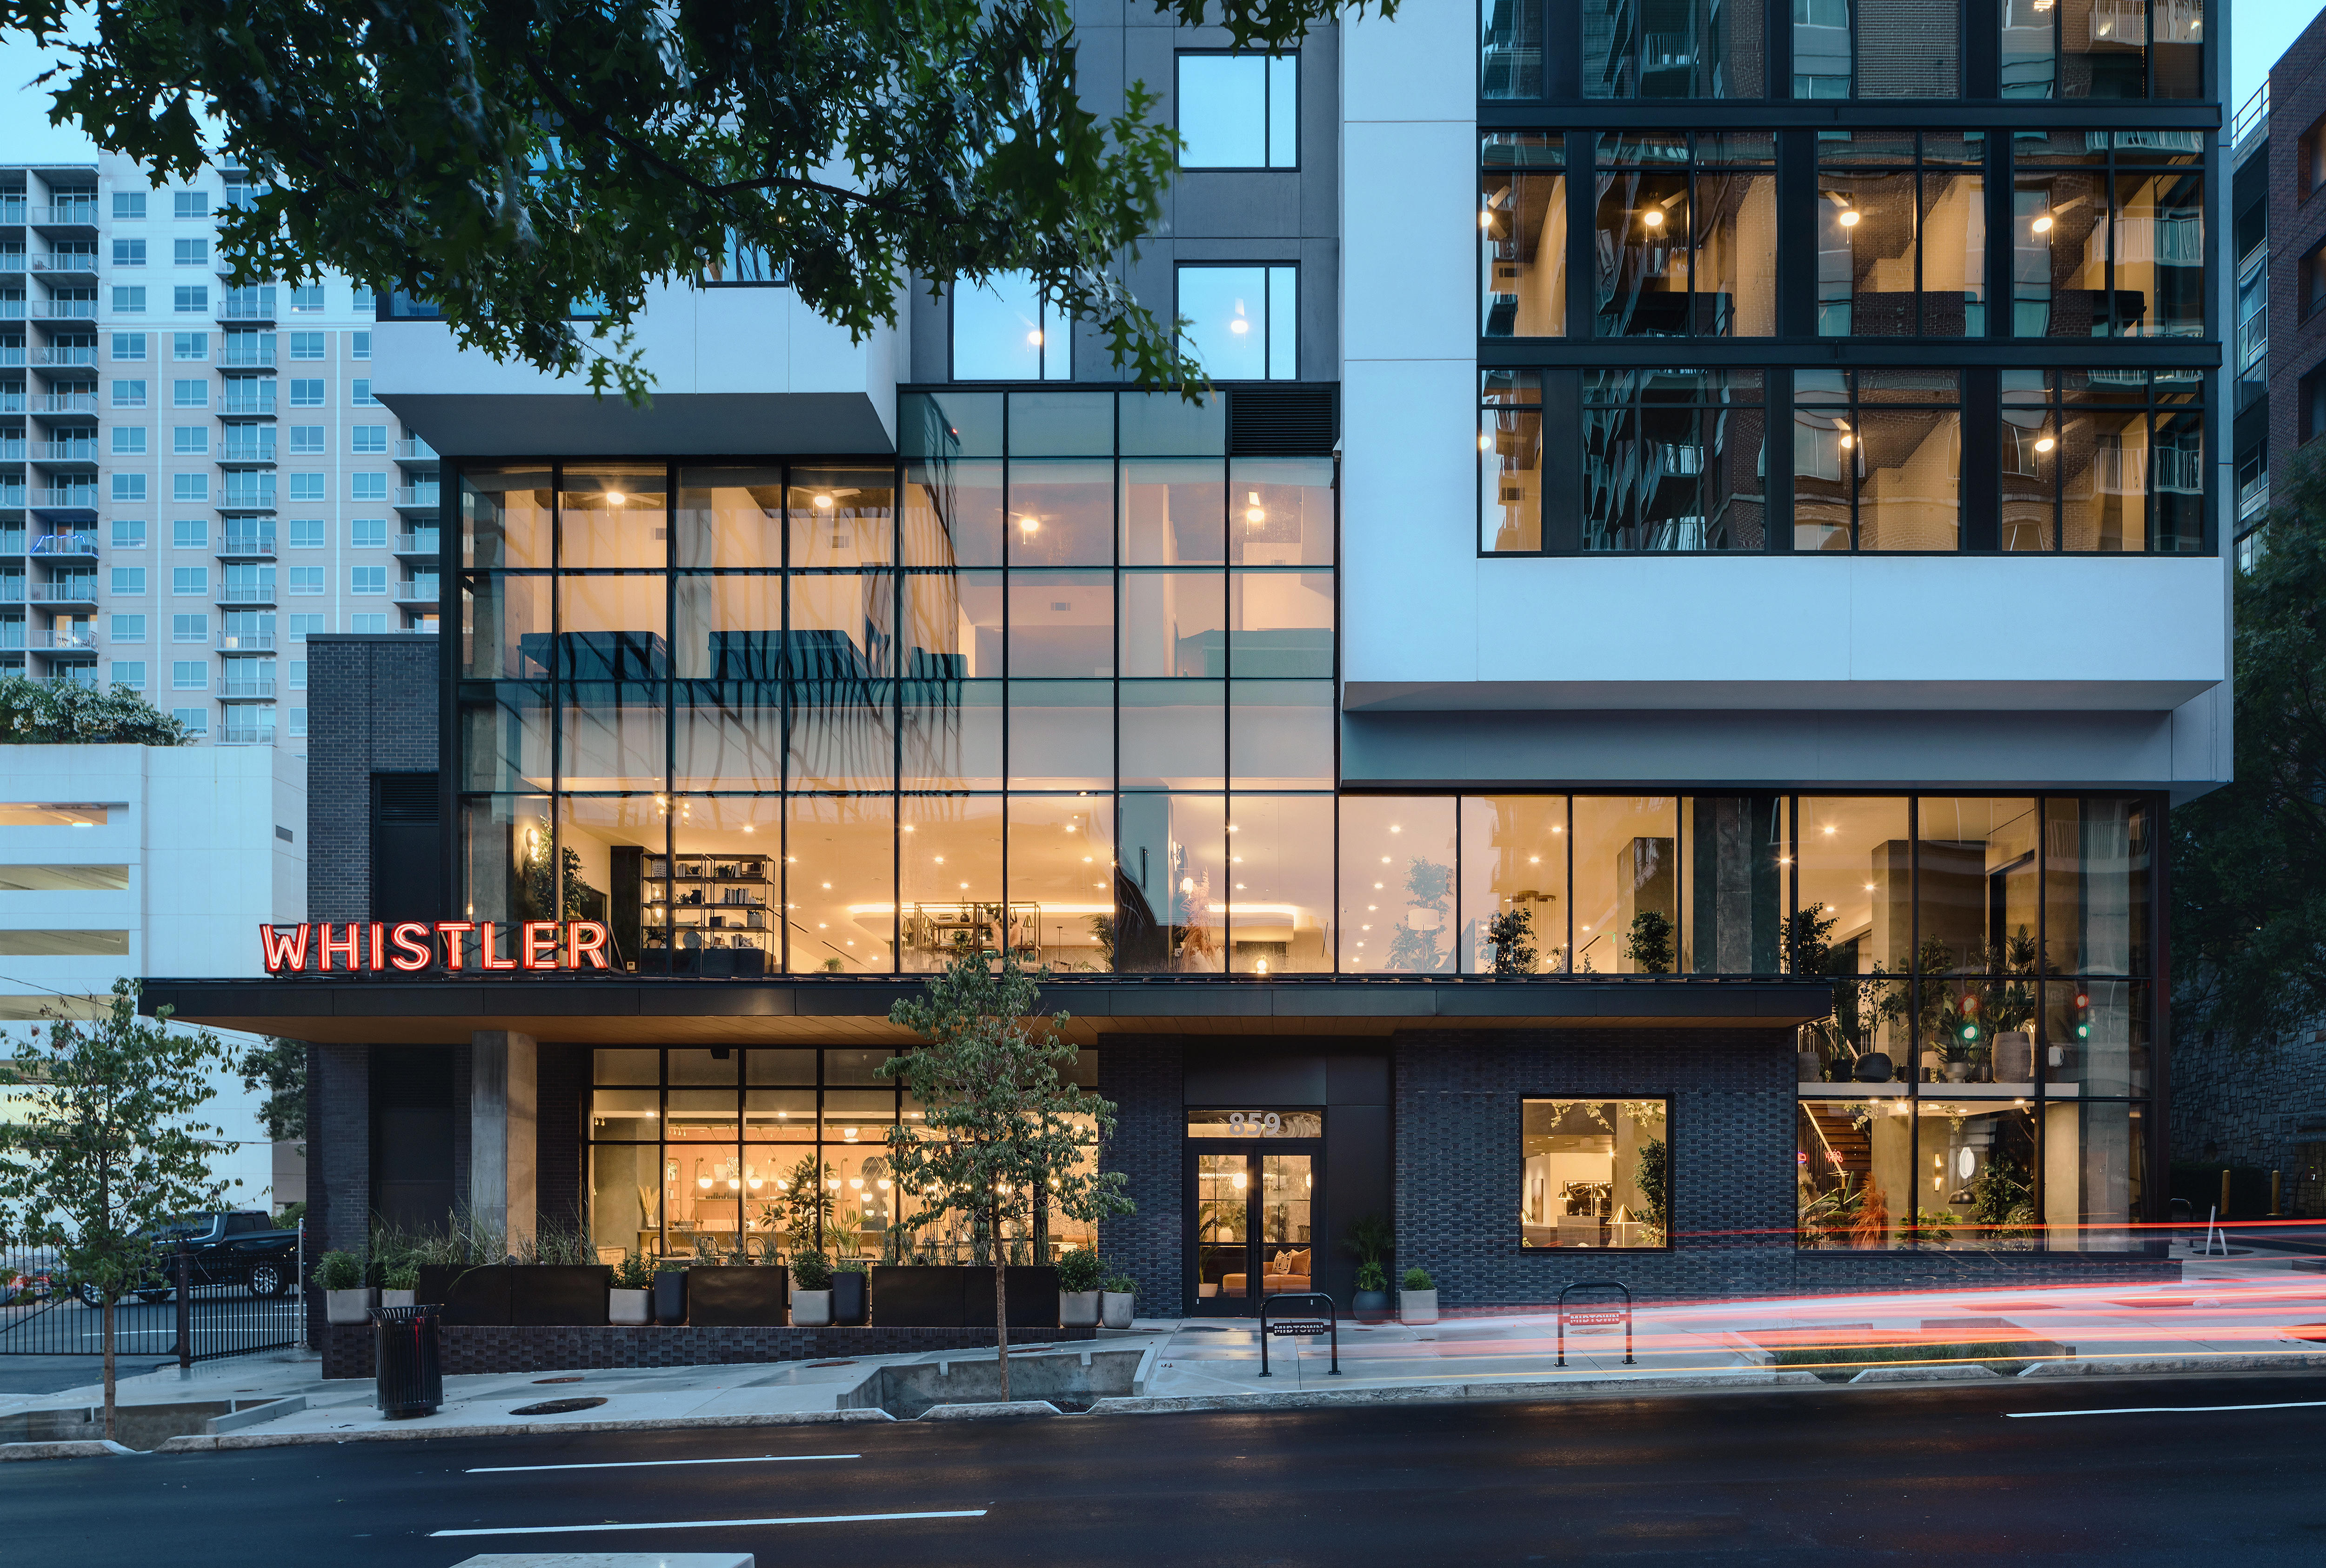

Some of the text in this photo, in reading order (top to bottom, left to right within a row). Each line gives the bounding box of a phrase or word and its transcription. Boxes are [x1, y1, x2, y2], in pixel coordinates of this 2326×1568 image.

[259, 920, 609, 972] WHISTLER
[1229, 1112, 1281, 1135] 859
[1570, 1314, 1619, 1323] MIDTOWN
[1274, 1324, 1323, 1334] MIDTOWN
